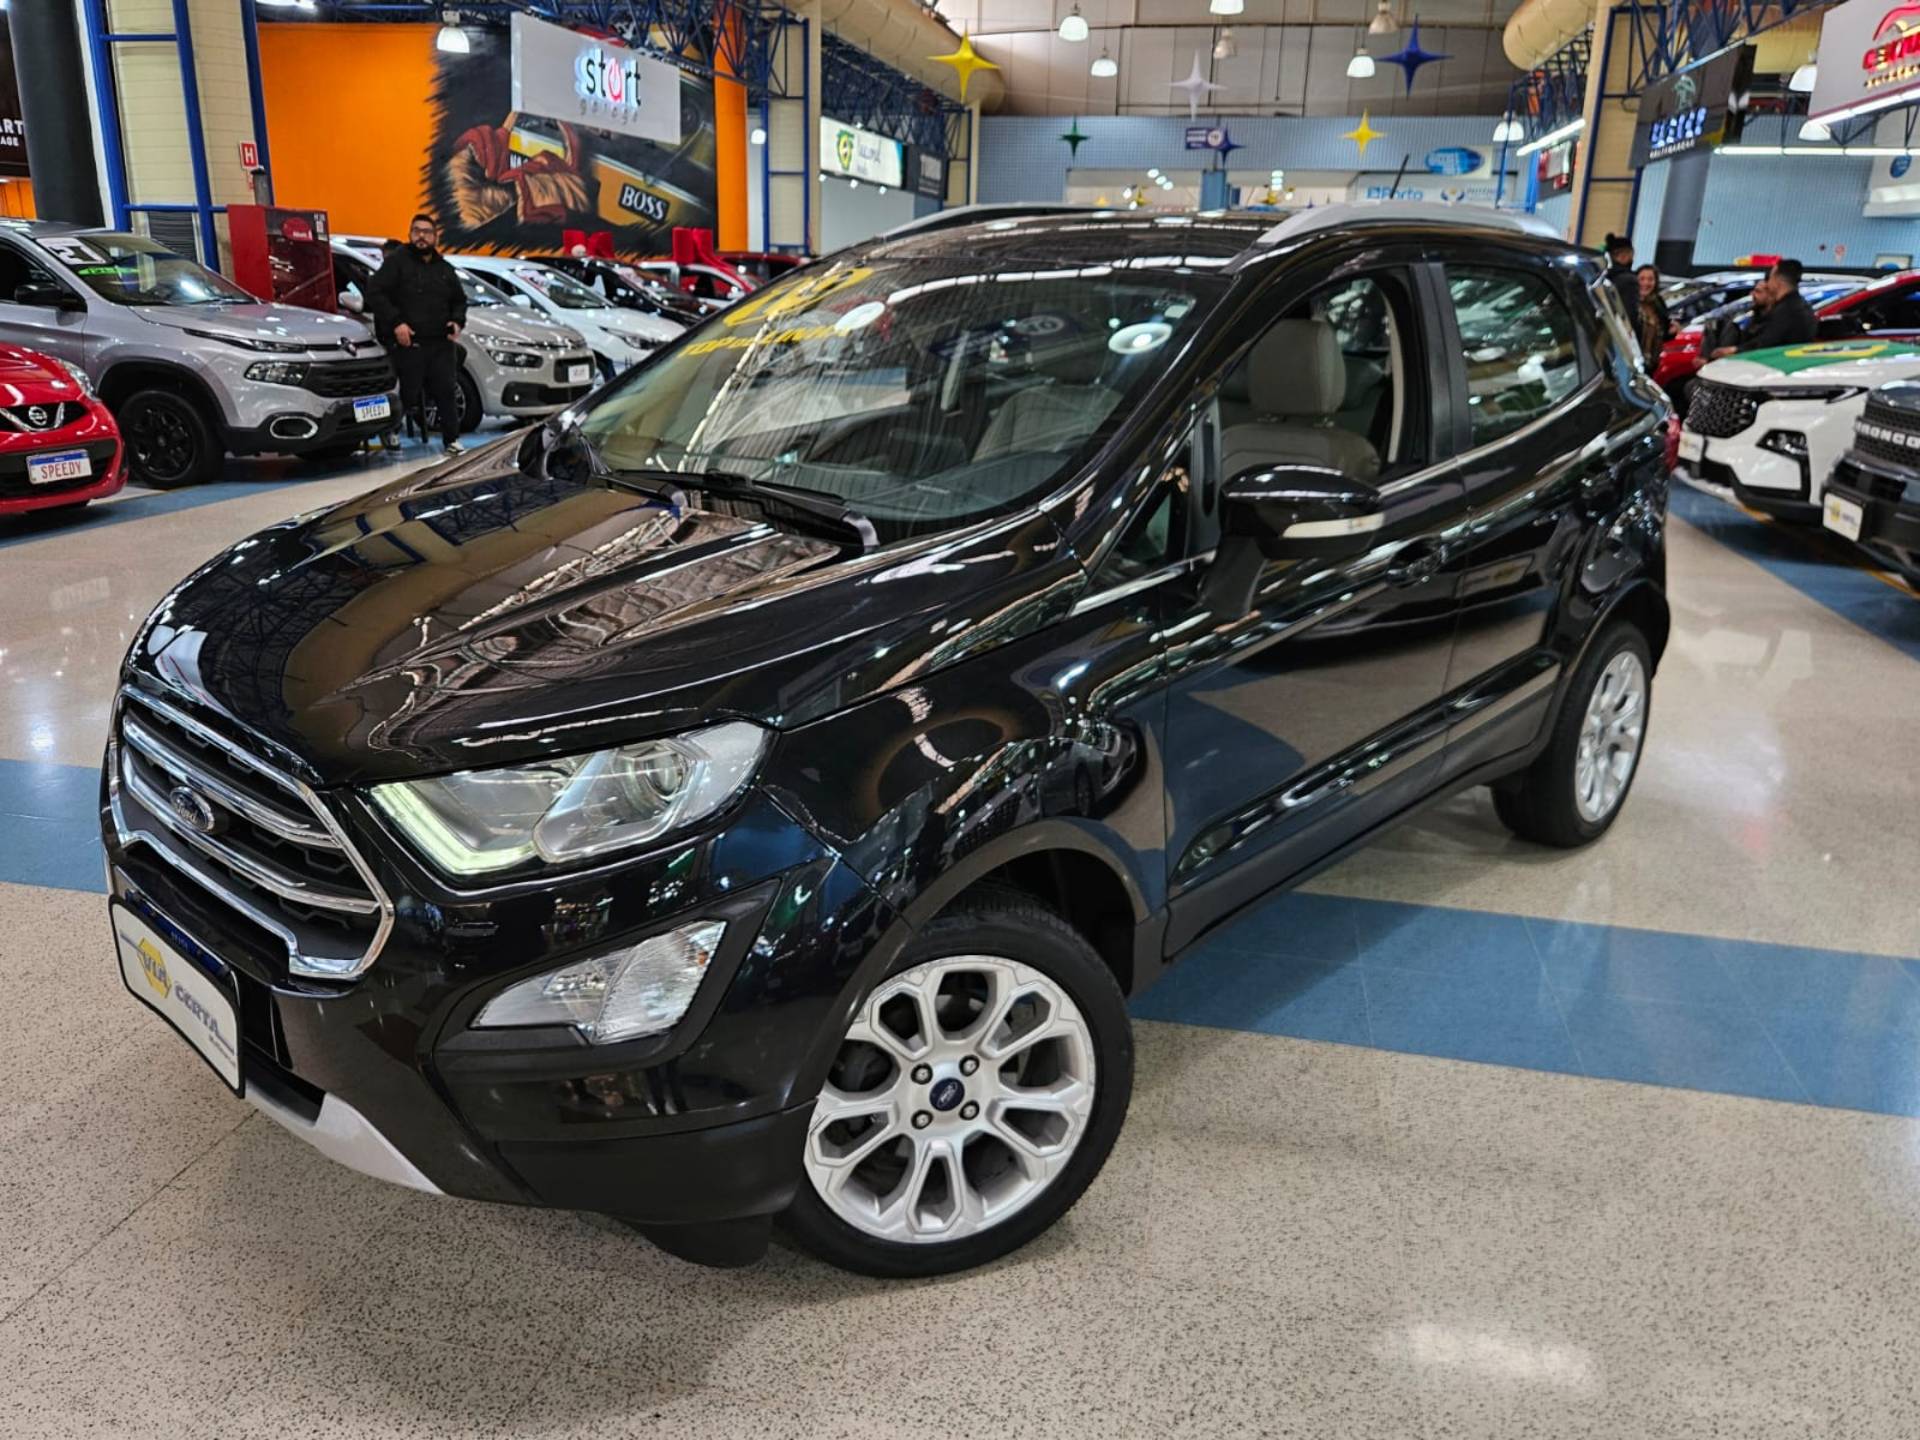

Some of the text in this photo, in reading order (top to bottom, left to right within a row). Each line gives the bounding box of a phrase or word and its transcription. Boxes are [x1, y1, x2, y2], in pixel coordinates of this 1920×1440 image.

[244, 147, 255, 164] H
[621, 185, 667, 220] BOSS
[40, 461, 81, 480] SPEEDY
[175, 983, 218, 1034] CERTA
